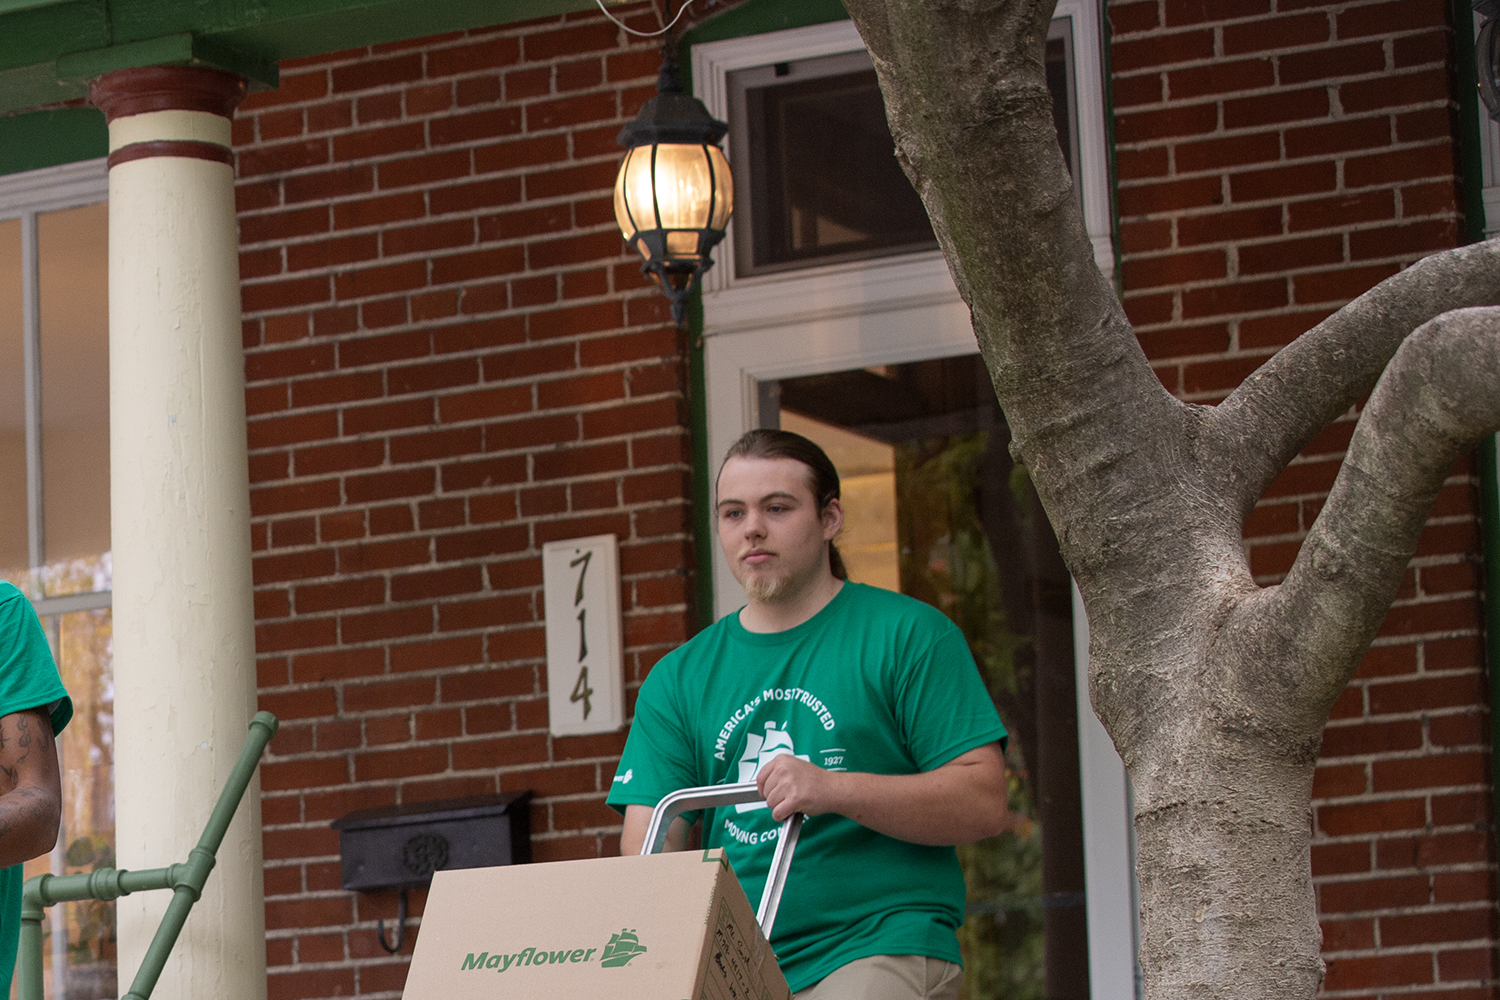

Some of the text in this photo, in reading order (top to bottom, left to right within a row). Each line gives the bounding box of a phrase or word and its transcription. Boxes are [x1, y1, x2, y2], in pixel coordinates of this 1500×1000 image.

[570, 551, 594, 721] 714
[795, 687, 836, 731] TRUSTED
[824, 756, 845, 767] 1927
[460, 947, 598, 974] Mayflower
